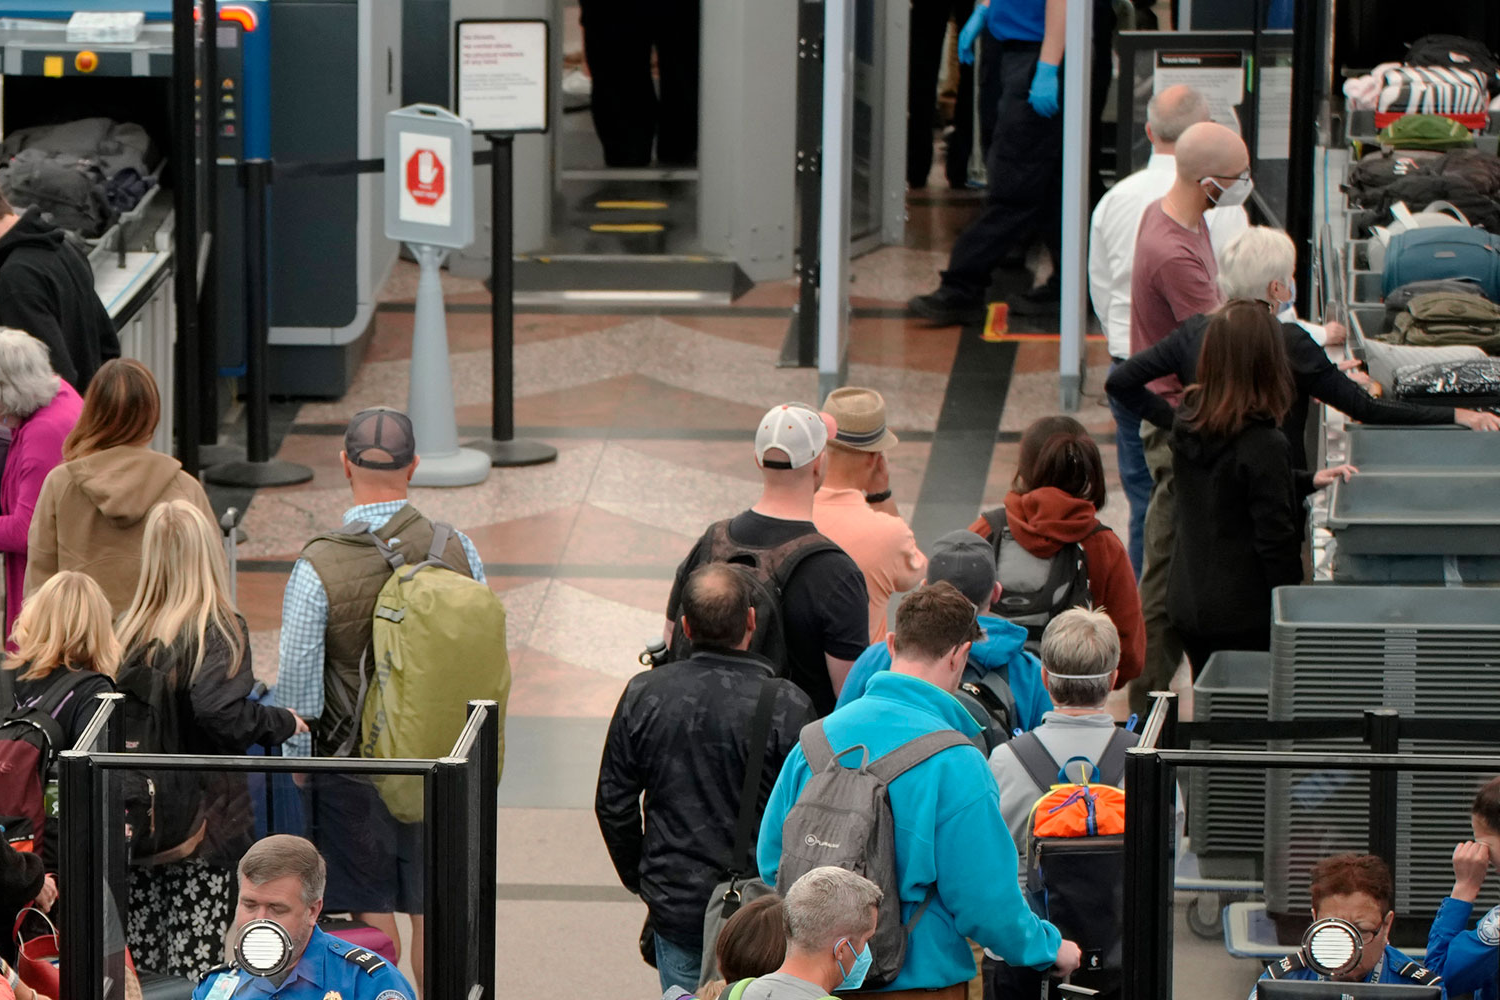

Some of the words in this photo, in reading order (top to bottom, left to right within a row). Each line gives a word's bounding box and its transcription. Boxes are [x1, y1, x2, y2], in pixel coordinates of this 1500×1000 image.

[356, 952, 375, 962] TSA
[1279, 956, 1292, 972] TSA
[1411, 968, 1429, 980] TSA
